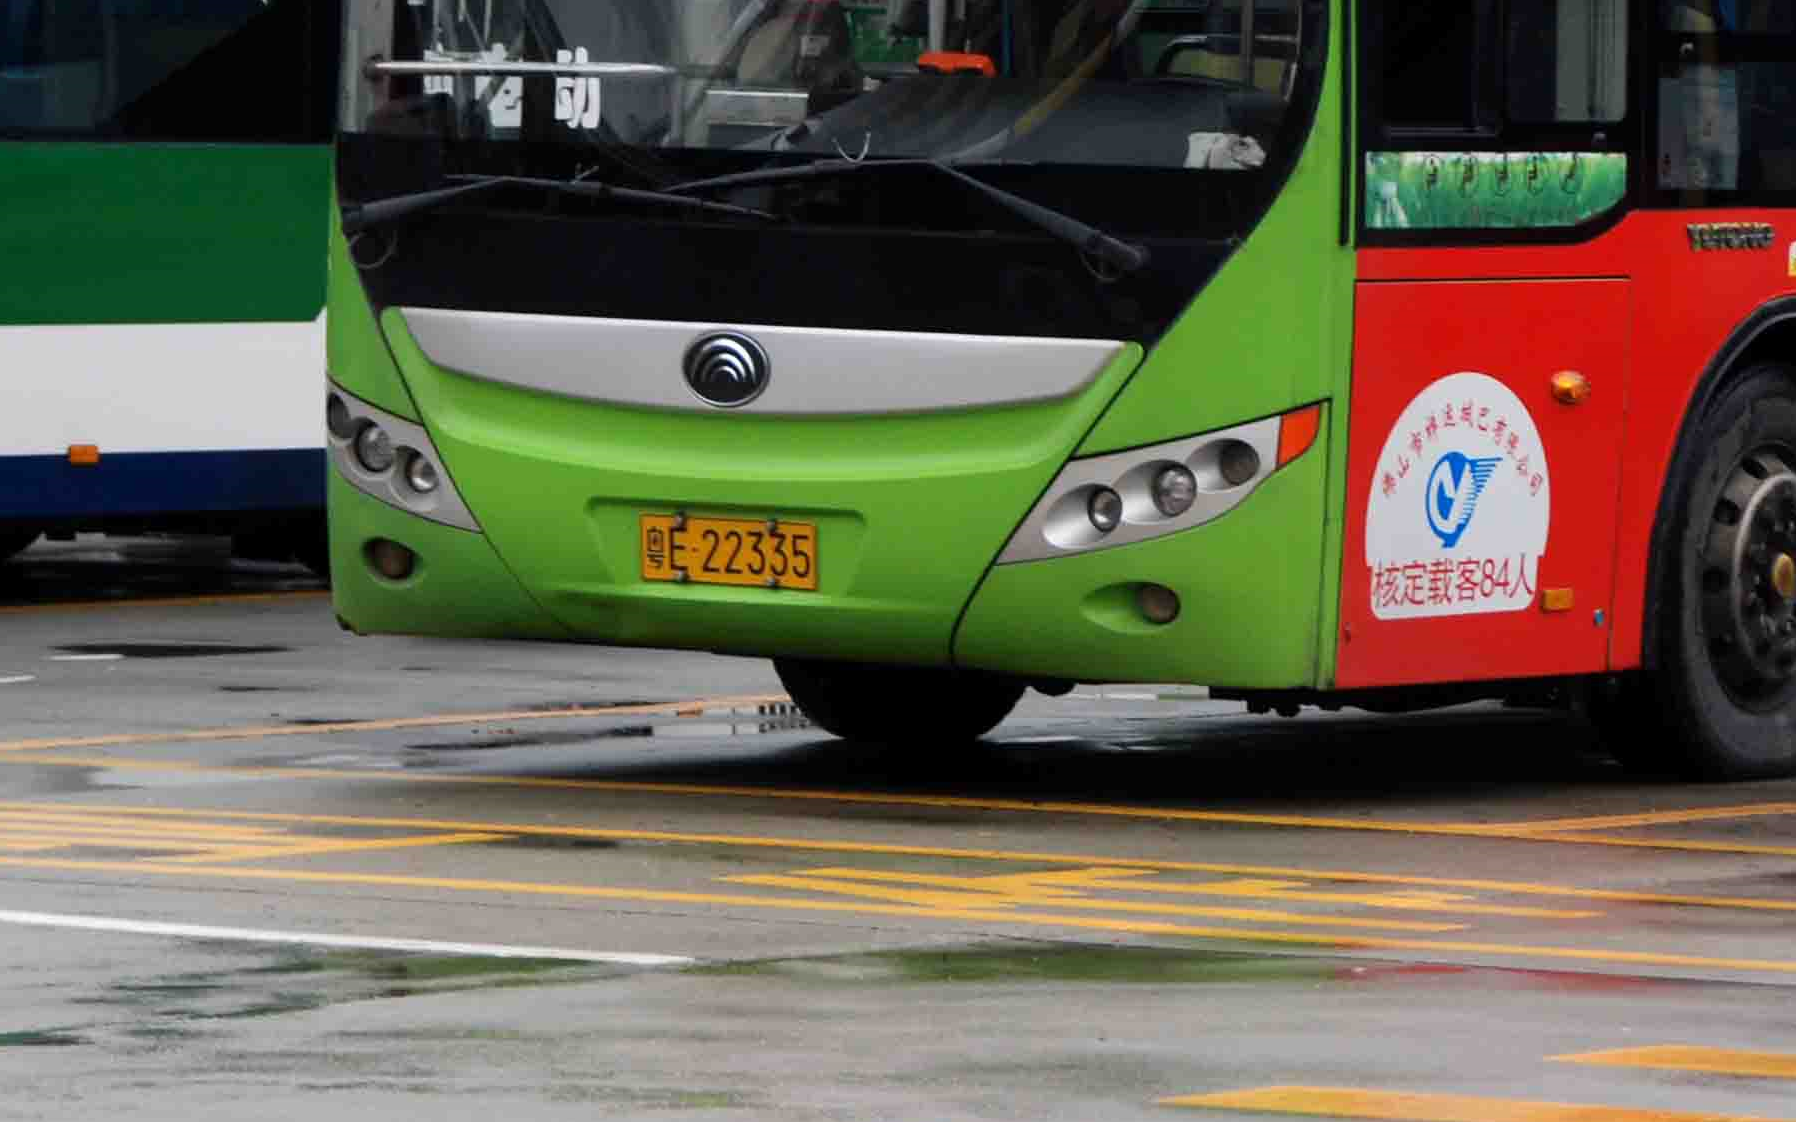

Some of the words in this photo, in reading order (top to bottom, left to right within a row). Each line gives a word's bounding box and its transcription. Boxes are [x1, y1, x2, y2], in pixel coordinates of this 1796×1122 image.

[1374, 553, 1534, 607] 核定载客84人
